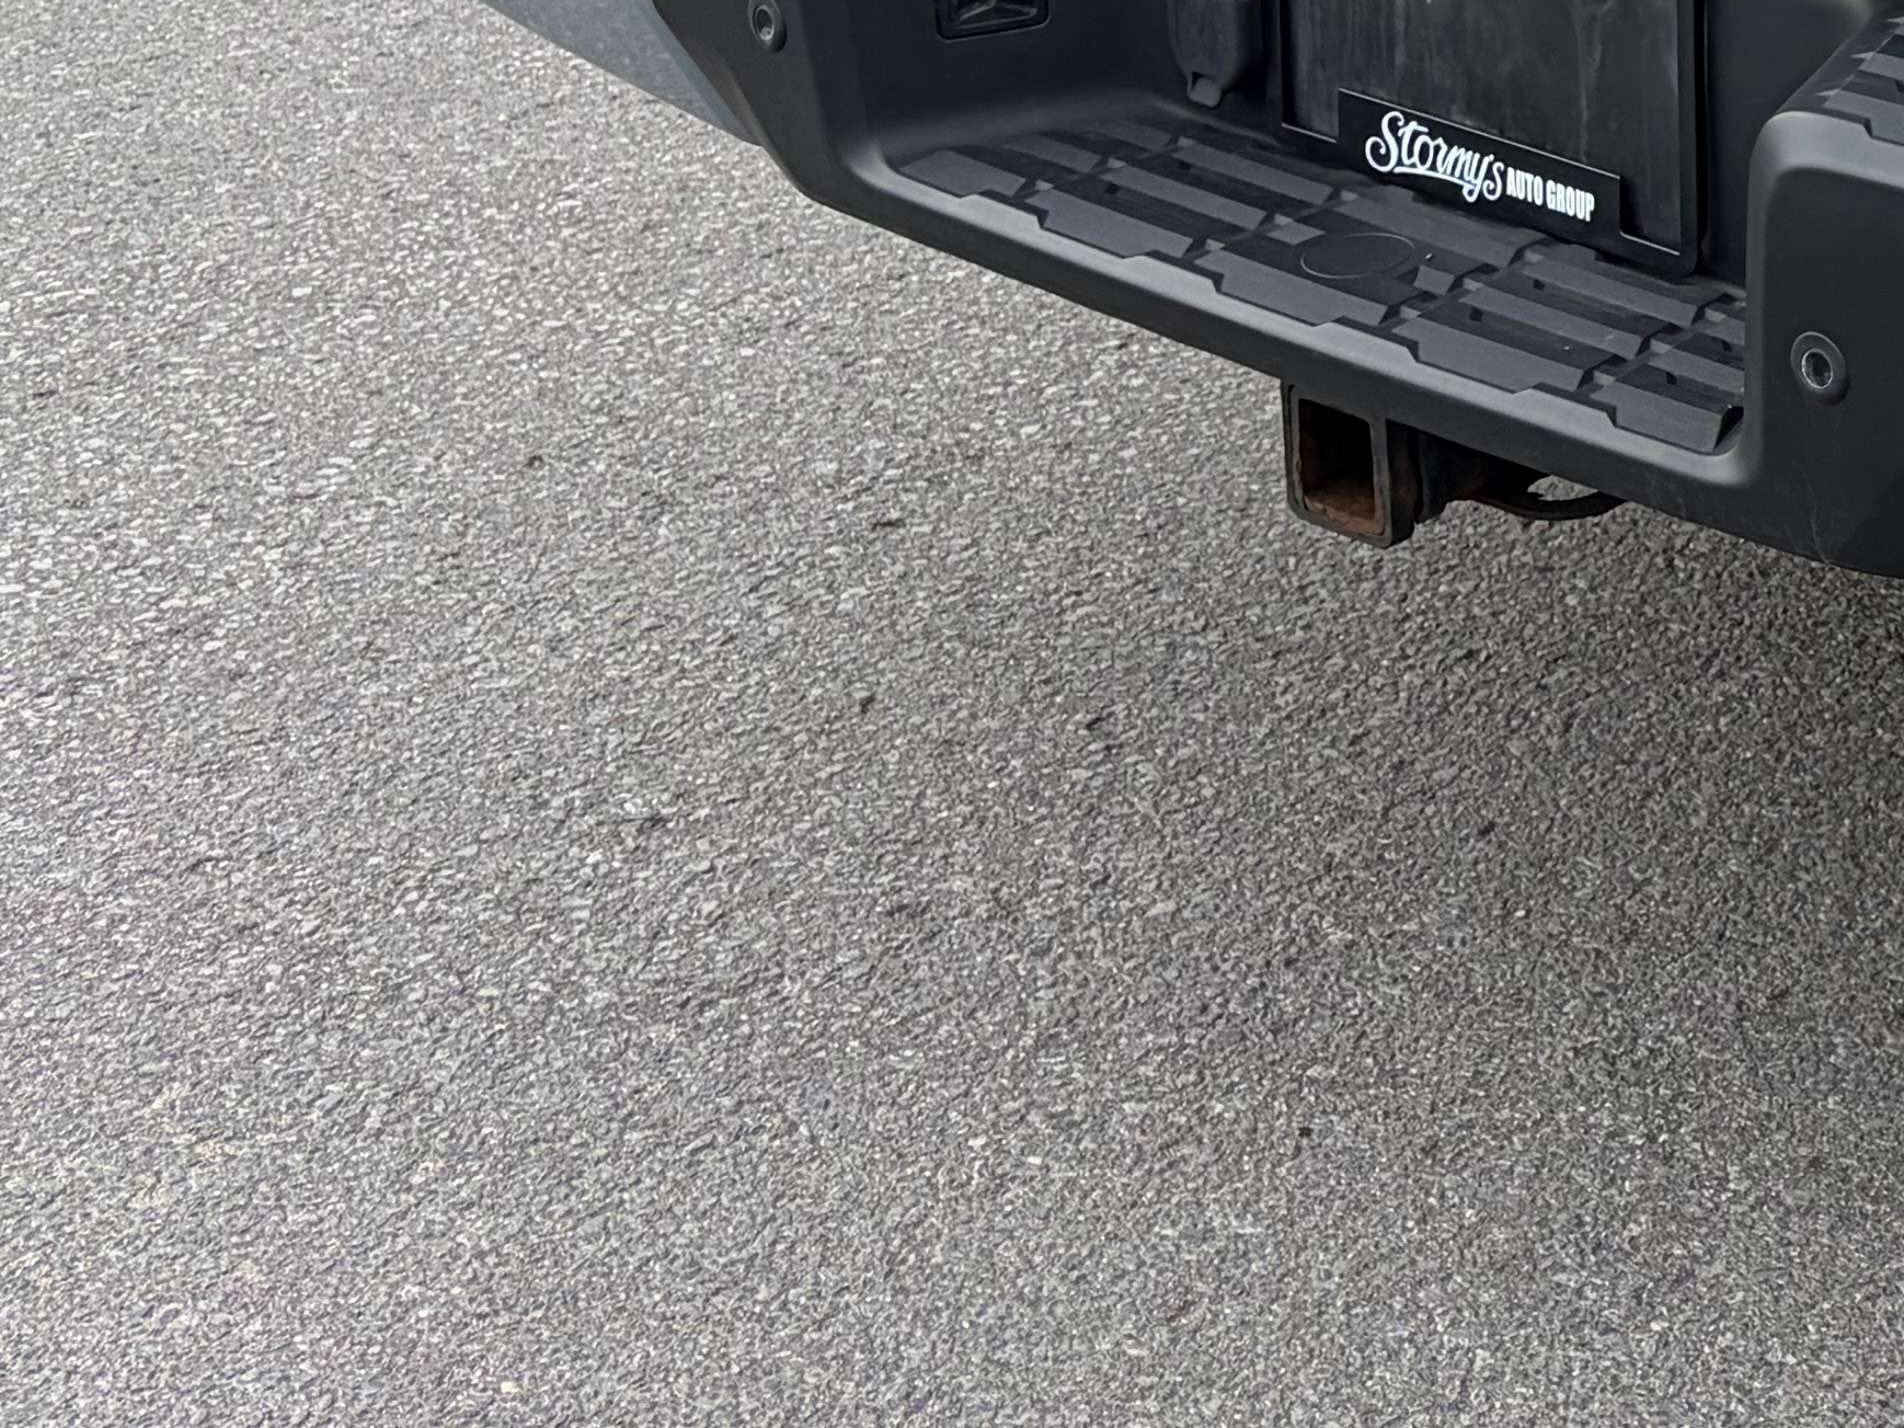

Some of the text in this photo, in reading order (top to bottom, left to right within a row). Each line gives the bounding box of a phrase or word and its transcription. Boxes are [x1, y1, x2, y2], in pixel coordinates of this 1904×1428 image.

[1365, 110, 1596, 223] Stormy's AUTO GROUP
